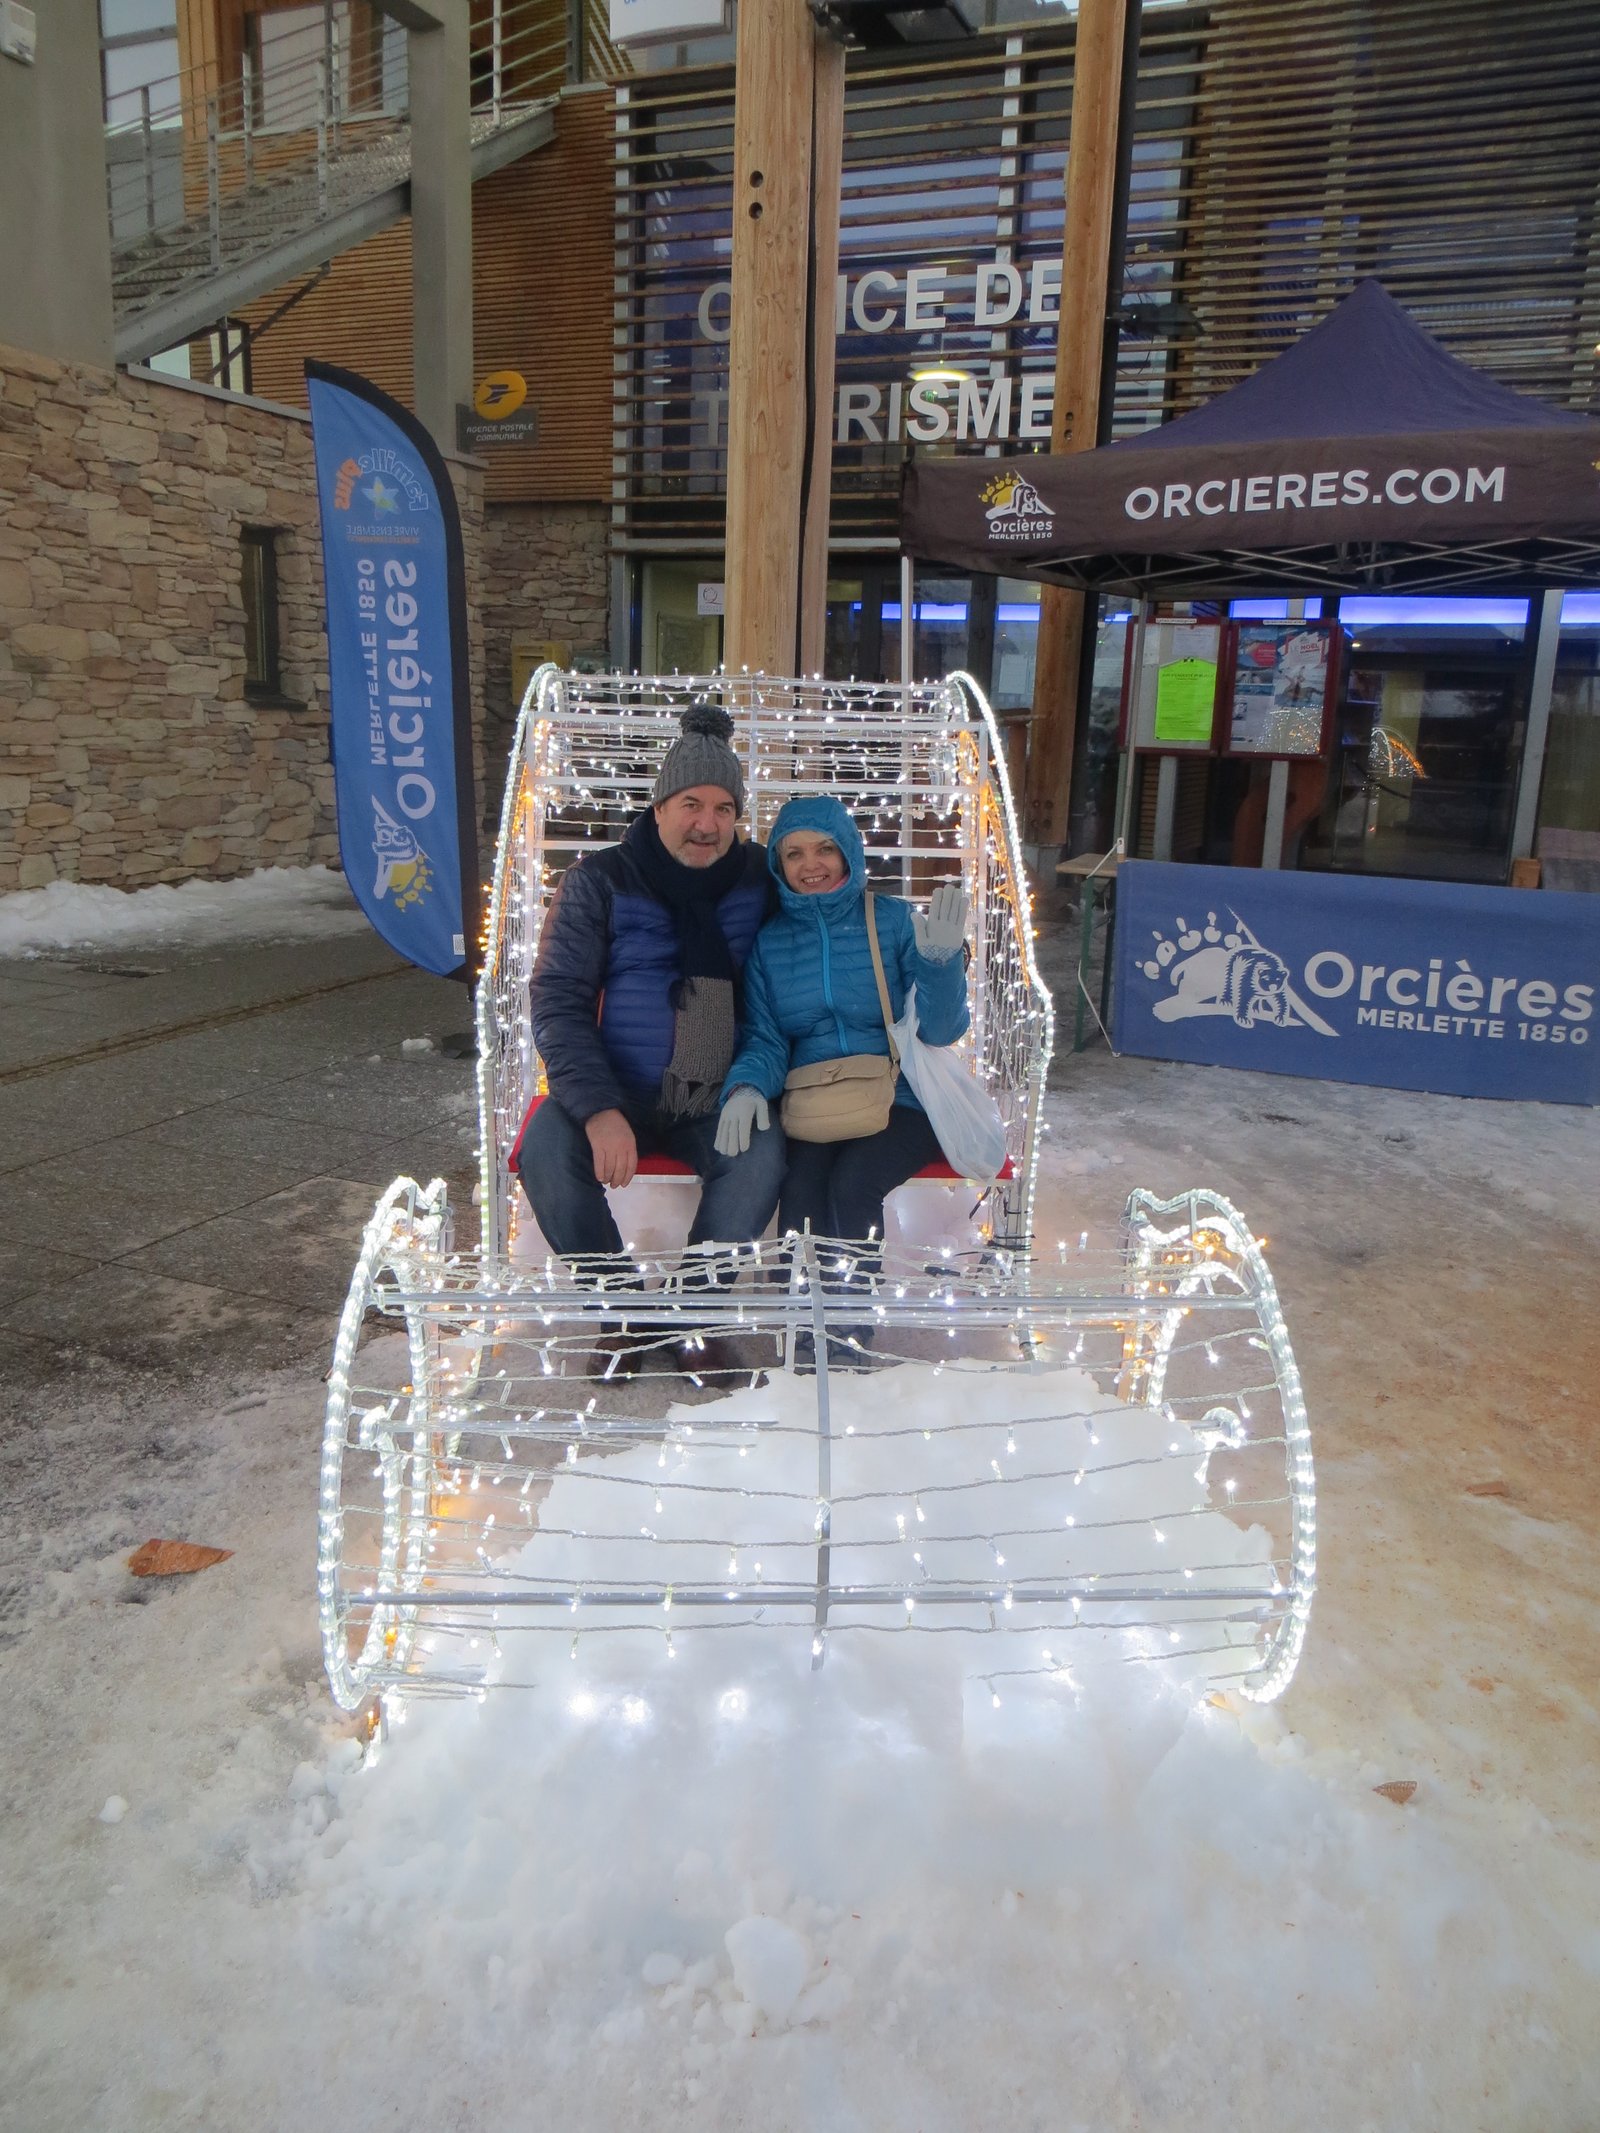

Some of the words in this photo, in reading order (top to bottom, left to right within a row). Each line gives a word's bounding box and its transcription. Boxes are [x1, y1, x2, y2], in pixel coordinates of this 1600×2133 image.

[698, 267, 947, 342] OICE
[974, 259, 1063, 327] DE
[466, 425, 498, 434] AGENCE
[500, 423, 534, 432] POSTALE
[694, 375, 1055, 447] TRISME
[475, 433, 524, 442] COMMUNALE
[1124, 466, 1505, 521] ORCIERES.COM
[990, 518, 1053, 533] Orcières
[1304, 951, 1594, 1021] Orcières
[1357, 1007, 1505, 1039] MERLETTE
[1517, 1022, 1589, 1045] 1850
